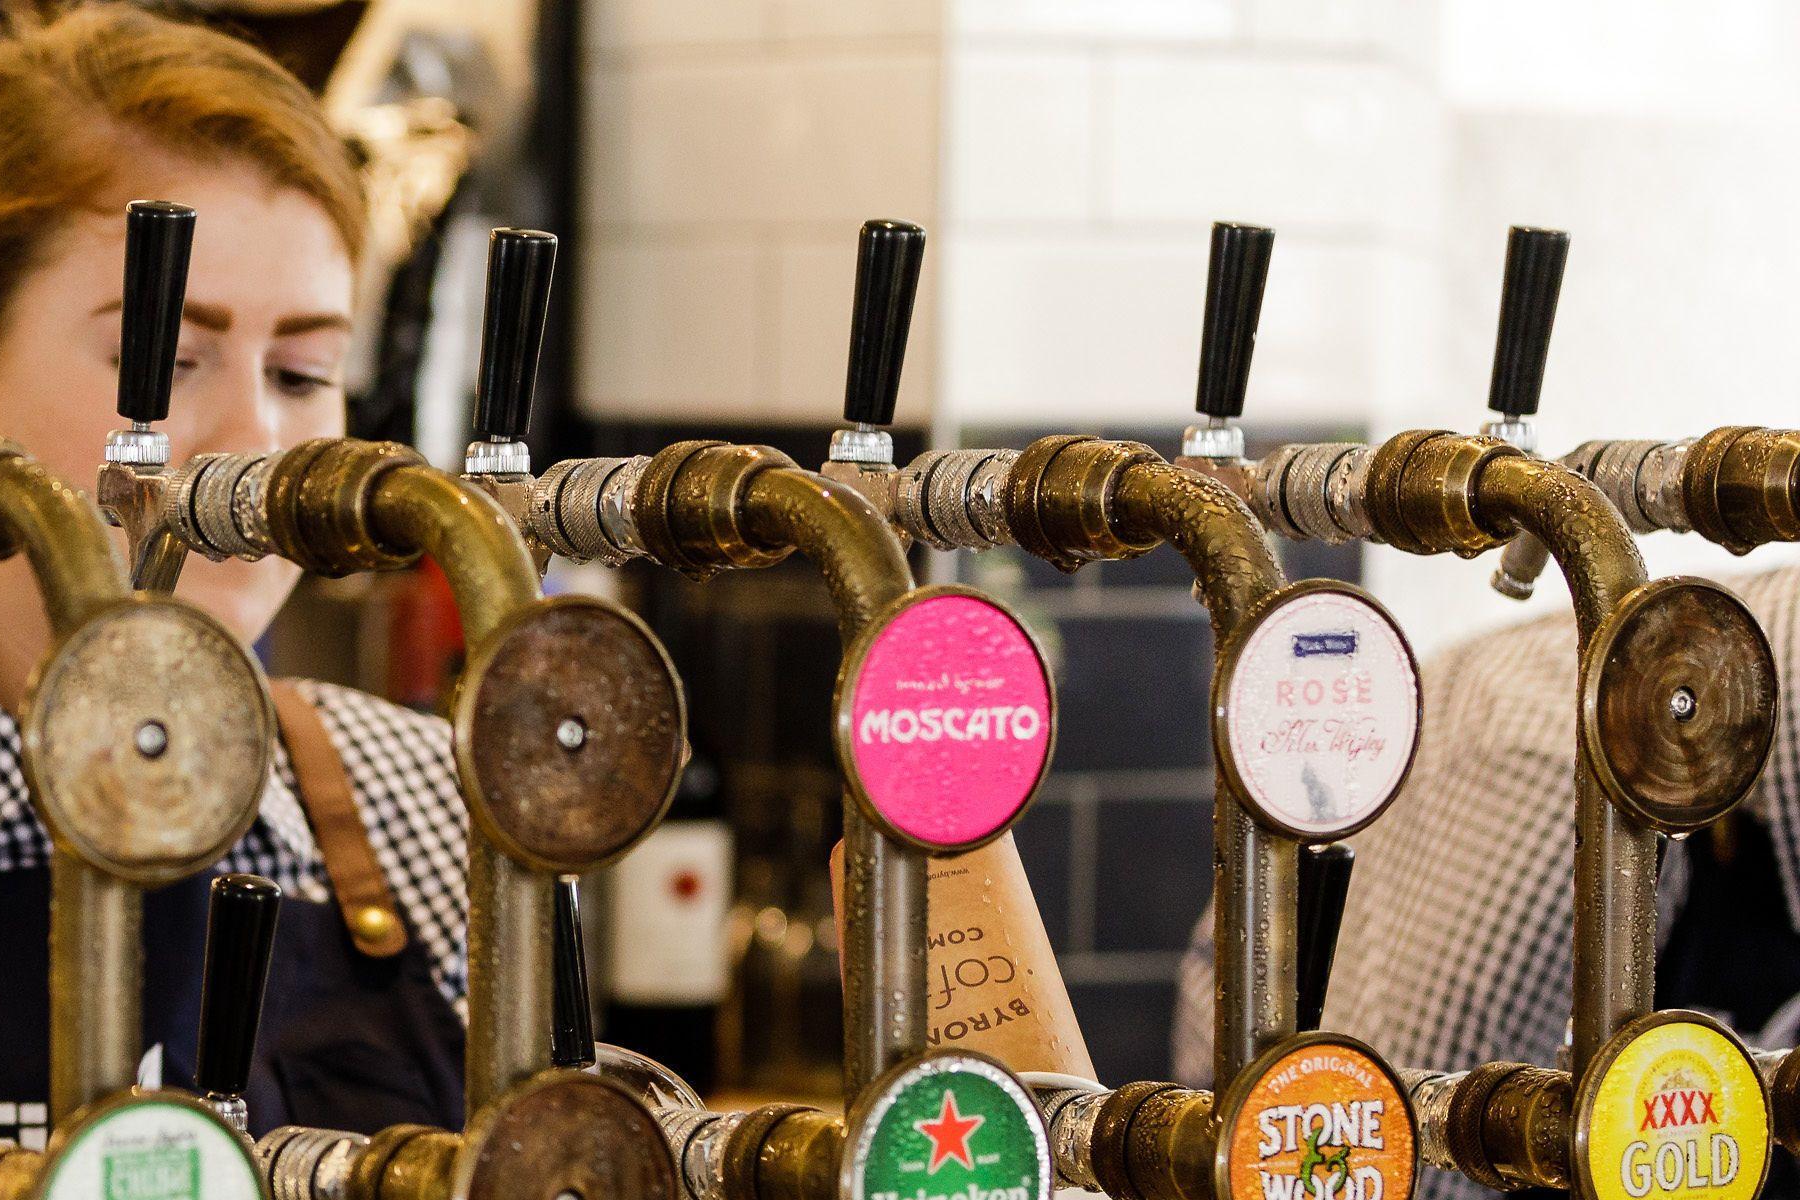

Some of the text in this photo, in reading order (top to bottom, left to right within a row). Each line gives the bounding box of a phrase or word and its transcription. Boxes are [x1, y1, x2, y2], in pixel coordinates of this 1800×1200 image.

[859, 705, 1041, 744] MOSCATO
[928, 927, 984, 950] COM
[927, 955, 1016, 1010] cof
[927, 998, 1031, 1046] BYRON
[1267, 1056, 1377, 1094] THE ORIGINAL
[1258, 1099, 1385, 1159] STONE
[1640, 1090, 1719, 1132] XXXX
[1620, 1132, 1740, 1198] GOLD
